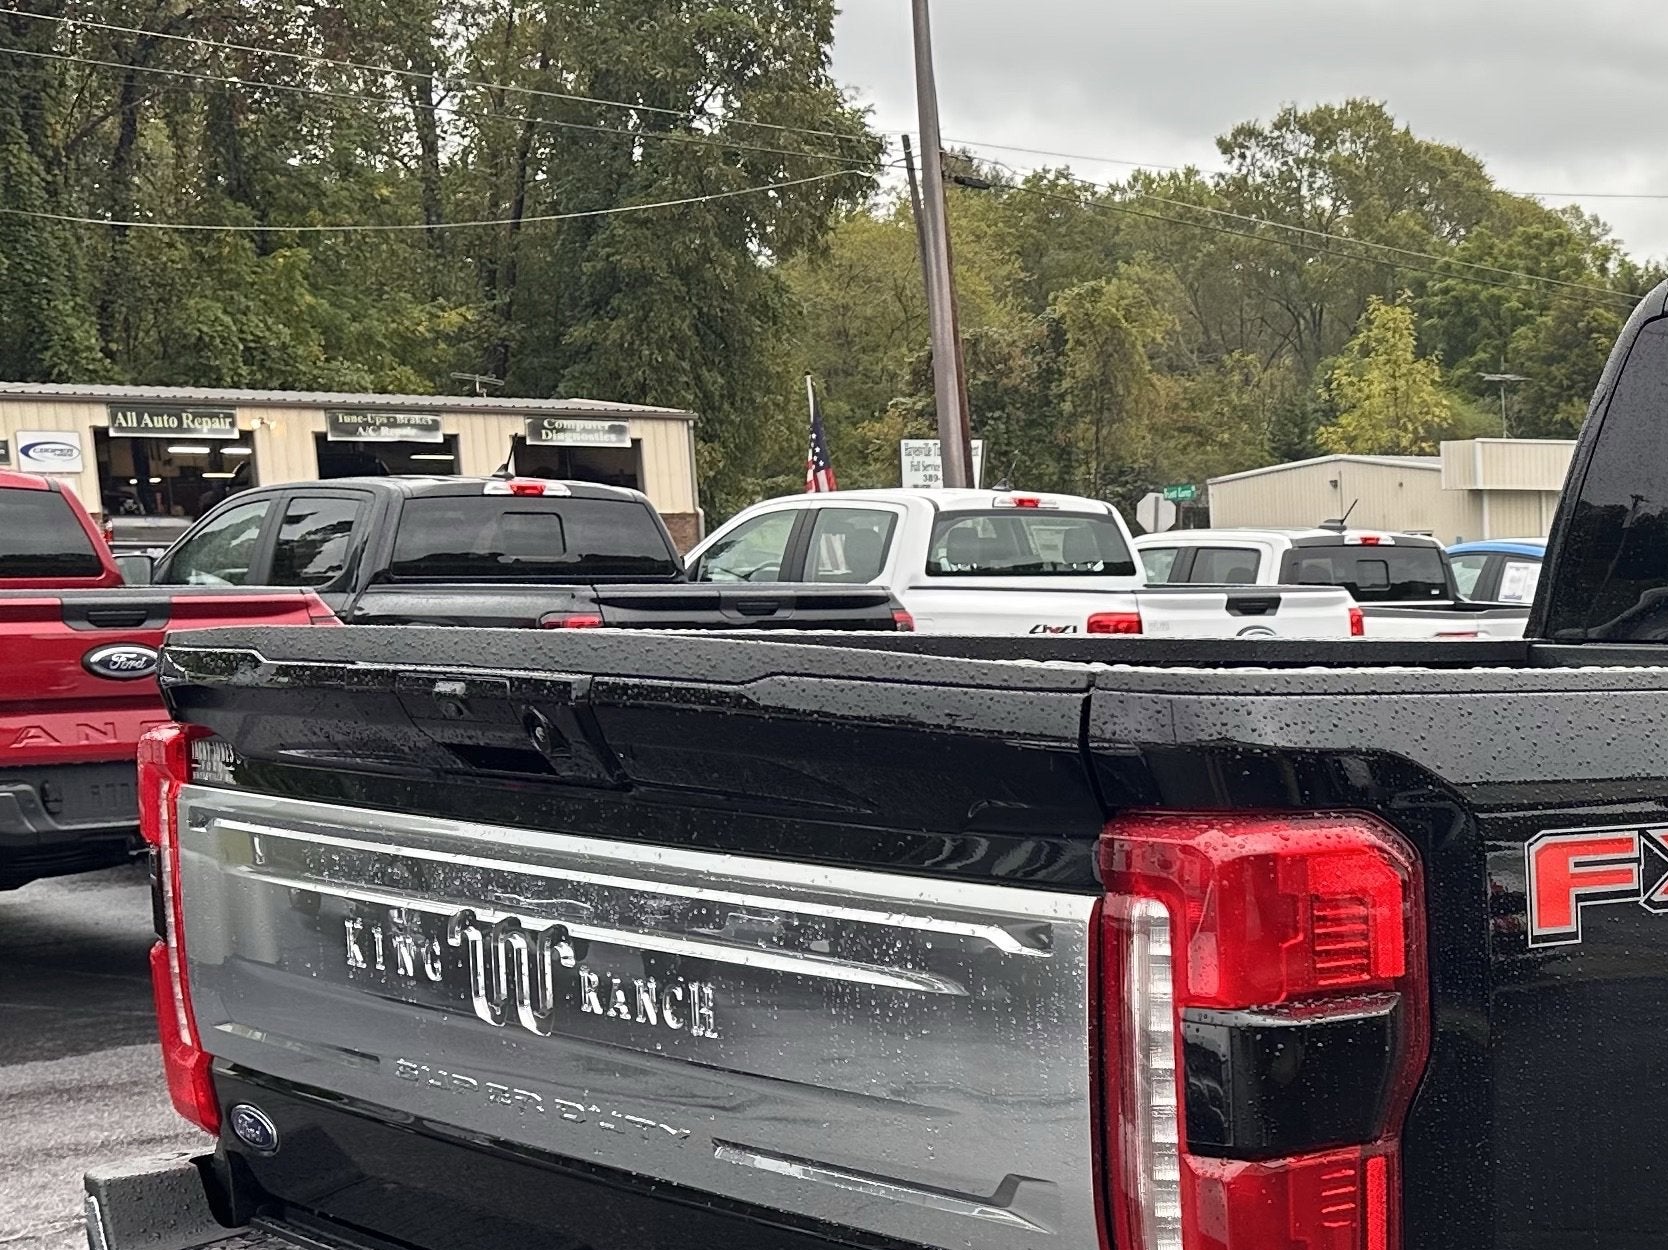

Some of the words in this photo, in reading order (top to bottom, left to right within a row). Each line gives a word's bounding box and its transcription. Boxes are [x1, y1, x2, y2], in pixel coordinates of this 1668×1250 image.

[114, 411, 137, 428] All
[141, 412, 178, 428] Auto
[181, 412, 233, 430] Repair
[543, 418, 609, 432] Computer
[109, 653, 147, 670] Ford
[344, 917, 443, 982] KING
[578, 964, 719, 1039] RANCH
[396, 1058, 545, 1116] SUPER
[554, 1098, 692, 1146] DUTY
